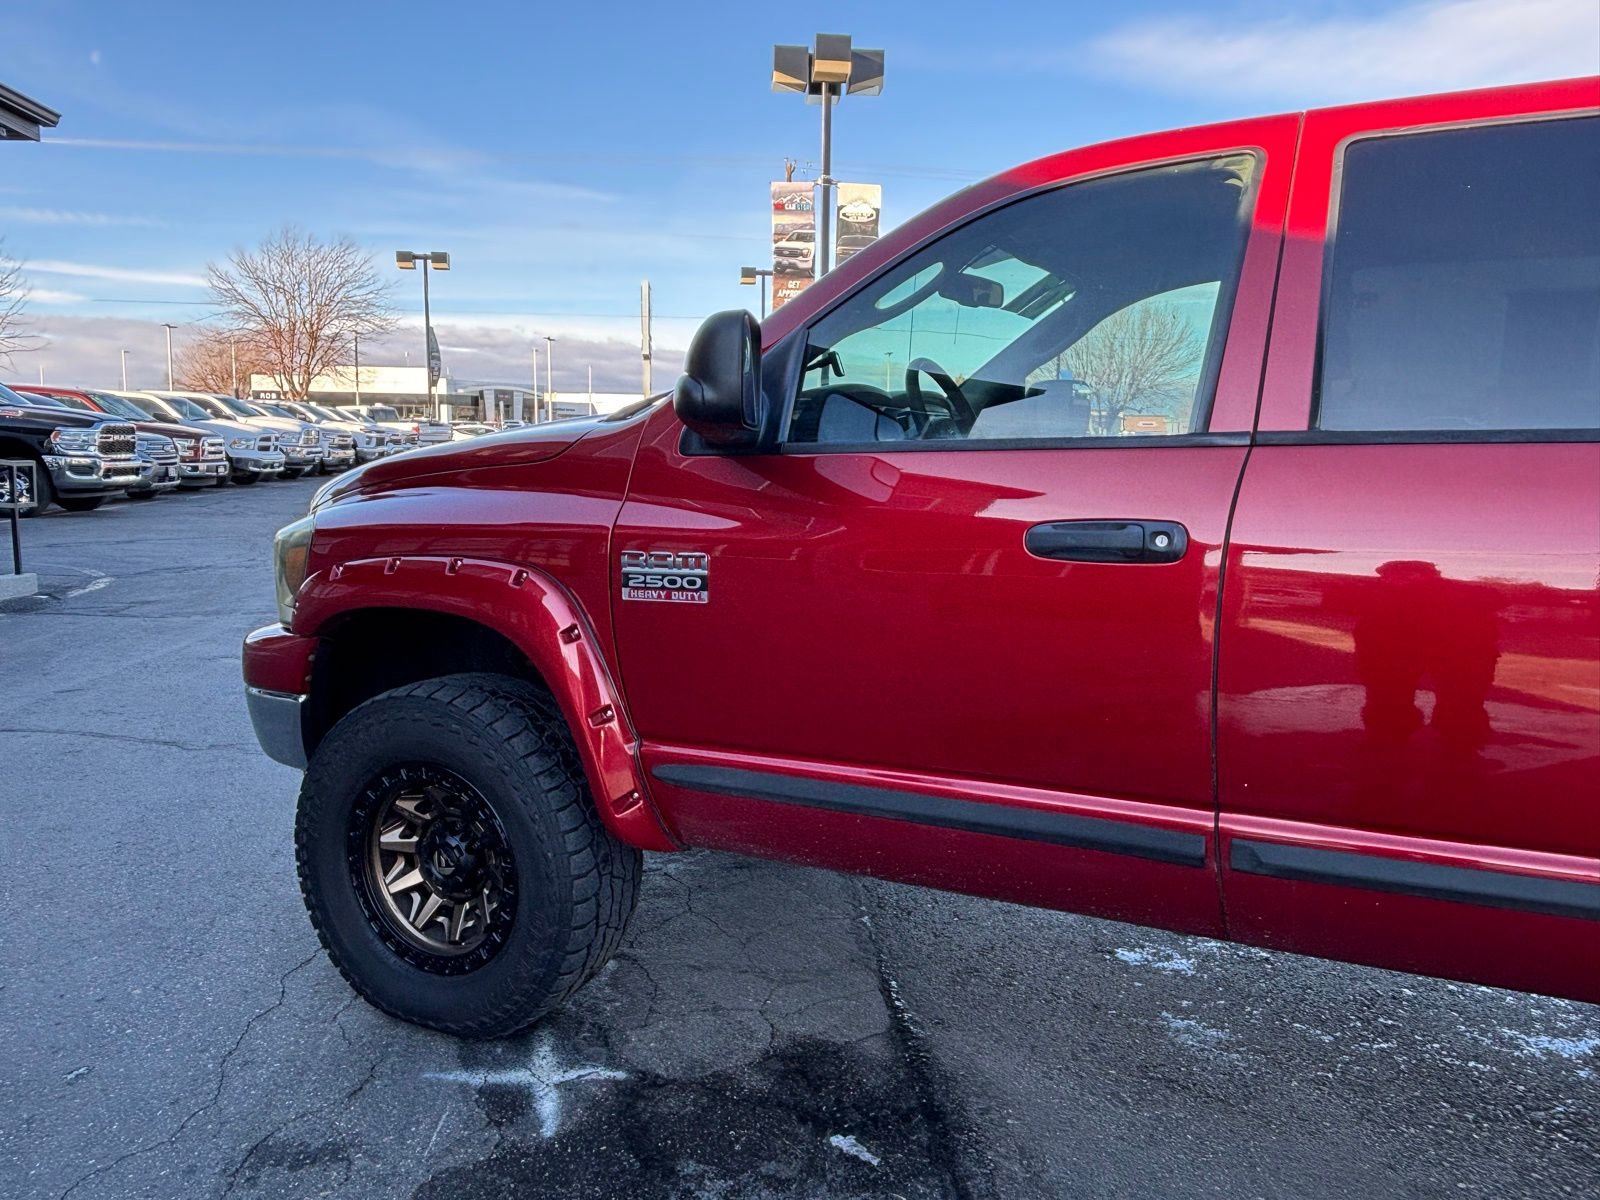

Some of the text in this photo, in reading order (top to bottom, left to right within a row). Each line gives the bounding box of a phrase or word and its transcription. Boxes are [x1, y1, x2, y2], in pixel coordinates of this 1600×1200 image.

[787, 280, 801, 289] GET
[777, 289, 803, 298] APPRO
[259, 392, 277, 400] ROB
[621, 550, 710, 570] RAM
[628, 574, 702, 589] 2500
[630, 589, 701, 601] HEAVY DUTY
